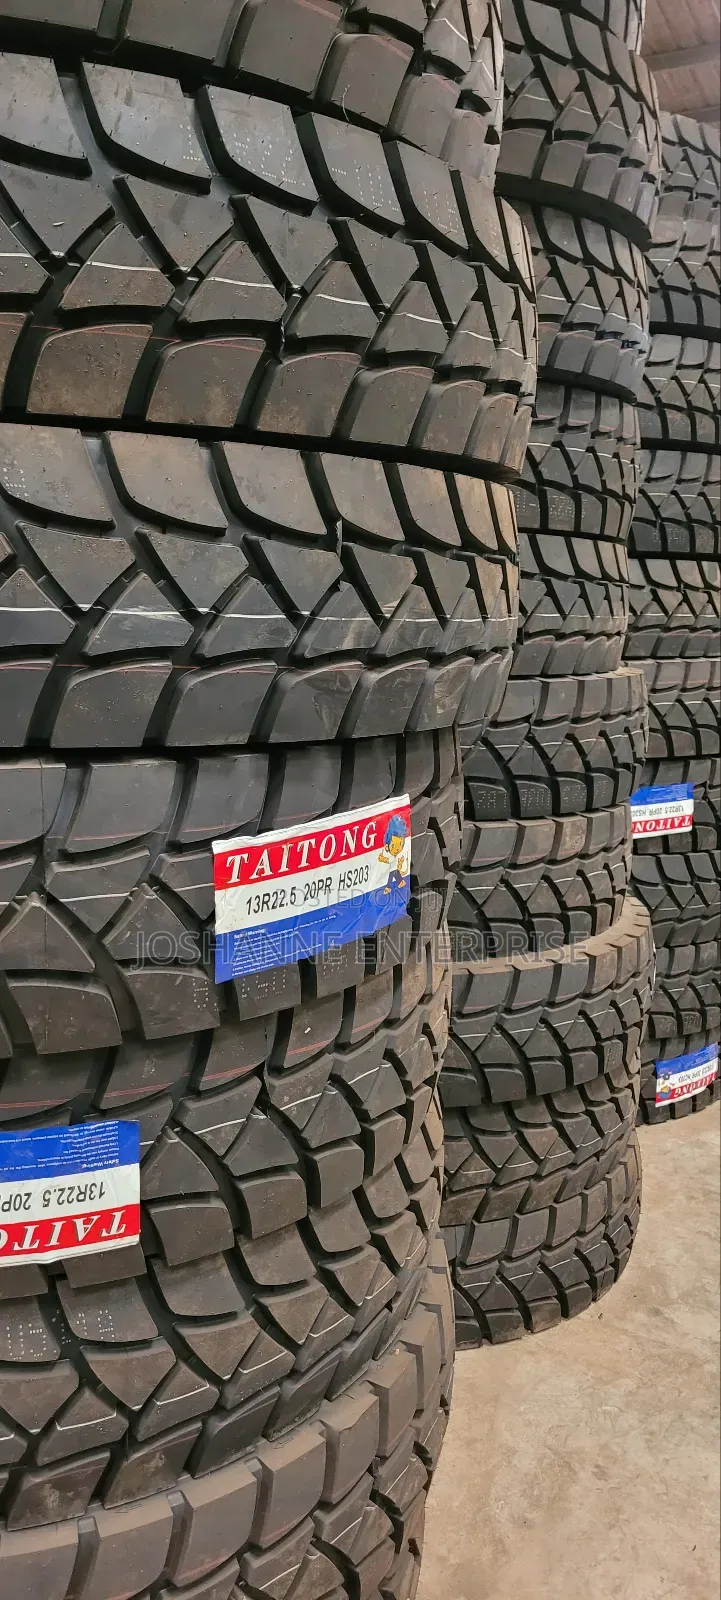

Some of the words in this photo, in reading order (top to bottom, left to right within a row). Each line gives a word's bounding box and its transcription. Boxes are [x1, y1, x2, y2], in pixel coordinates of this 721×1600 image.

[631, 815, 691, 833] TAITON
[225, 820, 378, 885] TAITONG
[246, 886, 297, 915] 13R22.5
[303, 876, 333, 903] 20PR
[338, 863, 370, 889] HS203
[0, 1192, 33, 1213] 20P
[42, 1181, 106, 1208] 13R22.5
